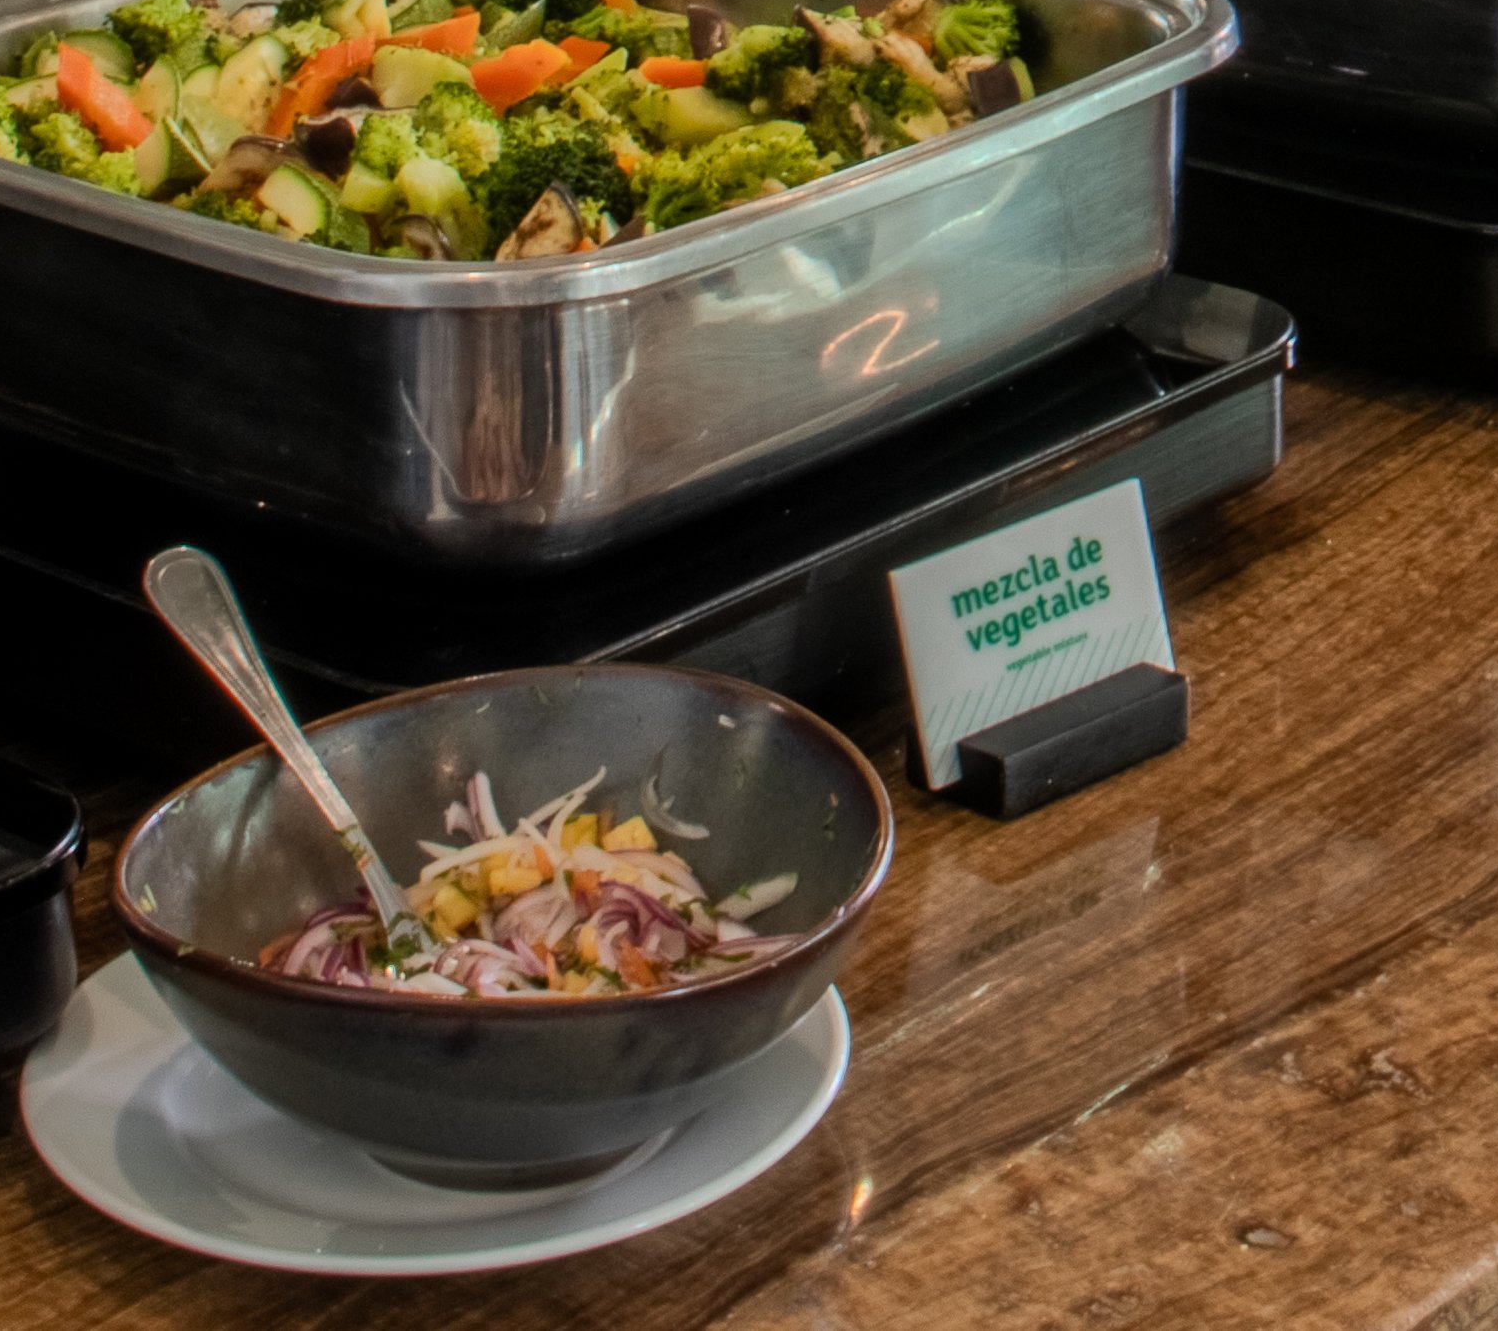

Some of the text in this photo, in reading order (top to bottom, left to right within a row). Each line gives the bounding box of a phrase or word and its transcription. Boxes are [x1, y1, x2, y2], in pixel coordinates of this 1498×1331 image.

[951, 536, 1103, 618] mezcla de
[965, 575, 1111, 652] vegetales
